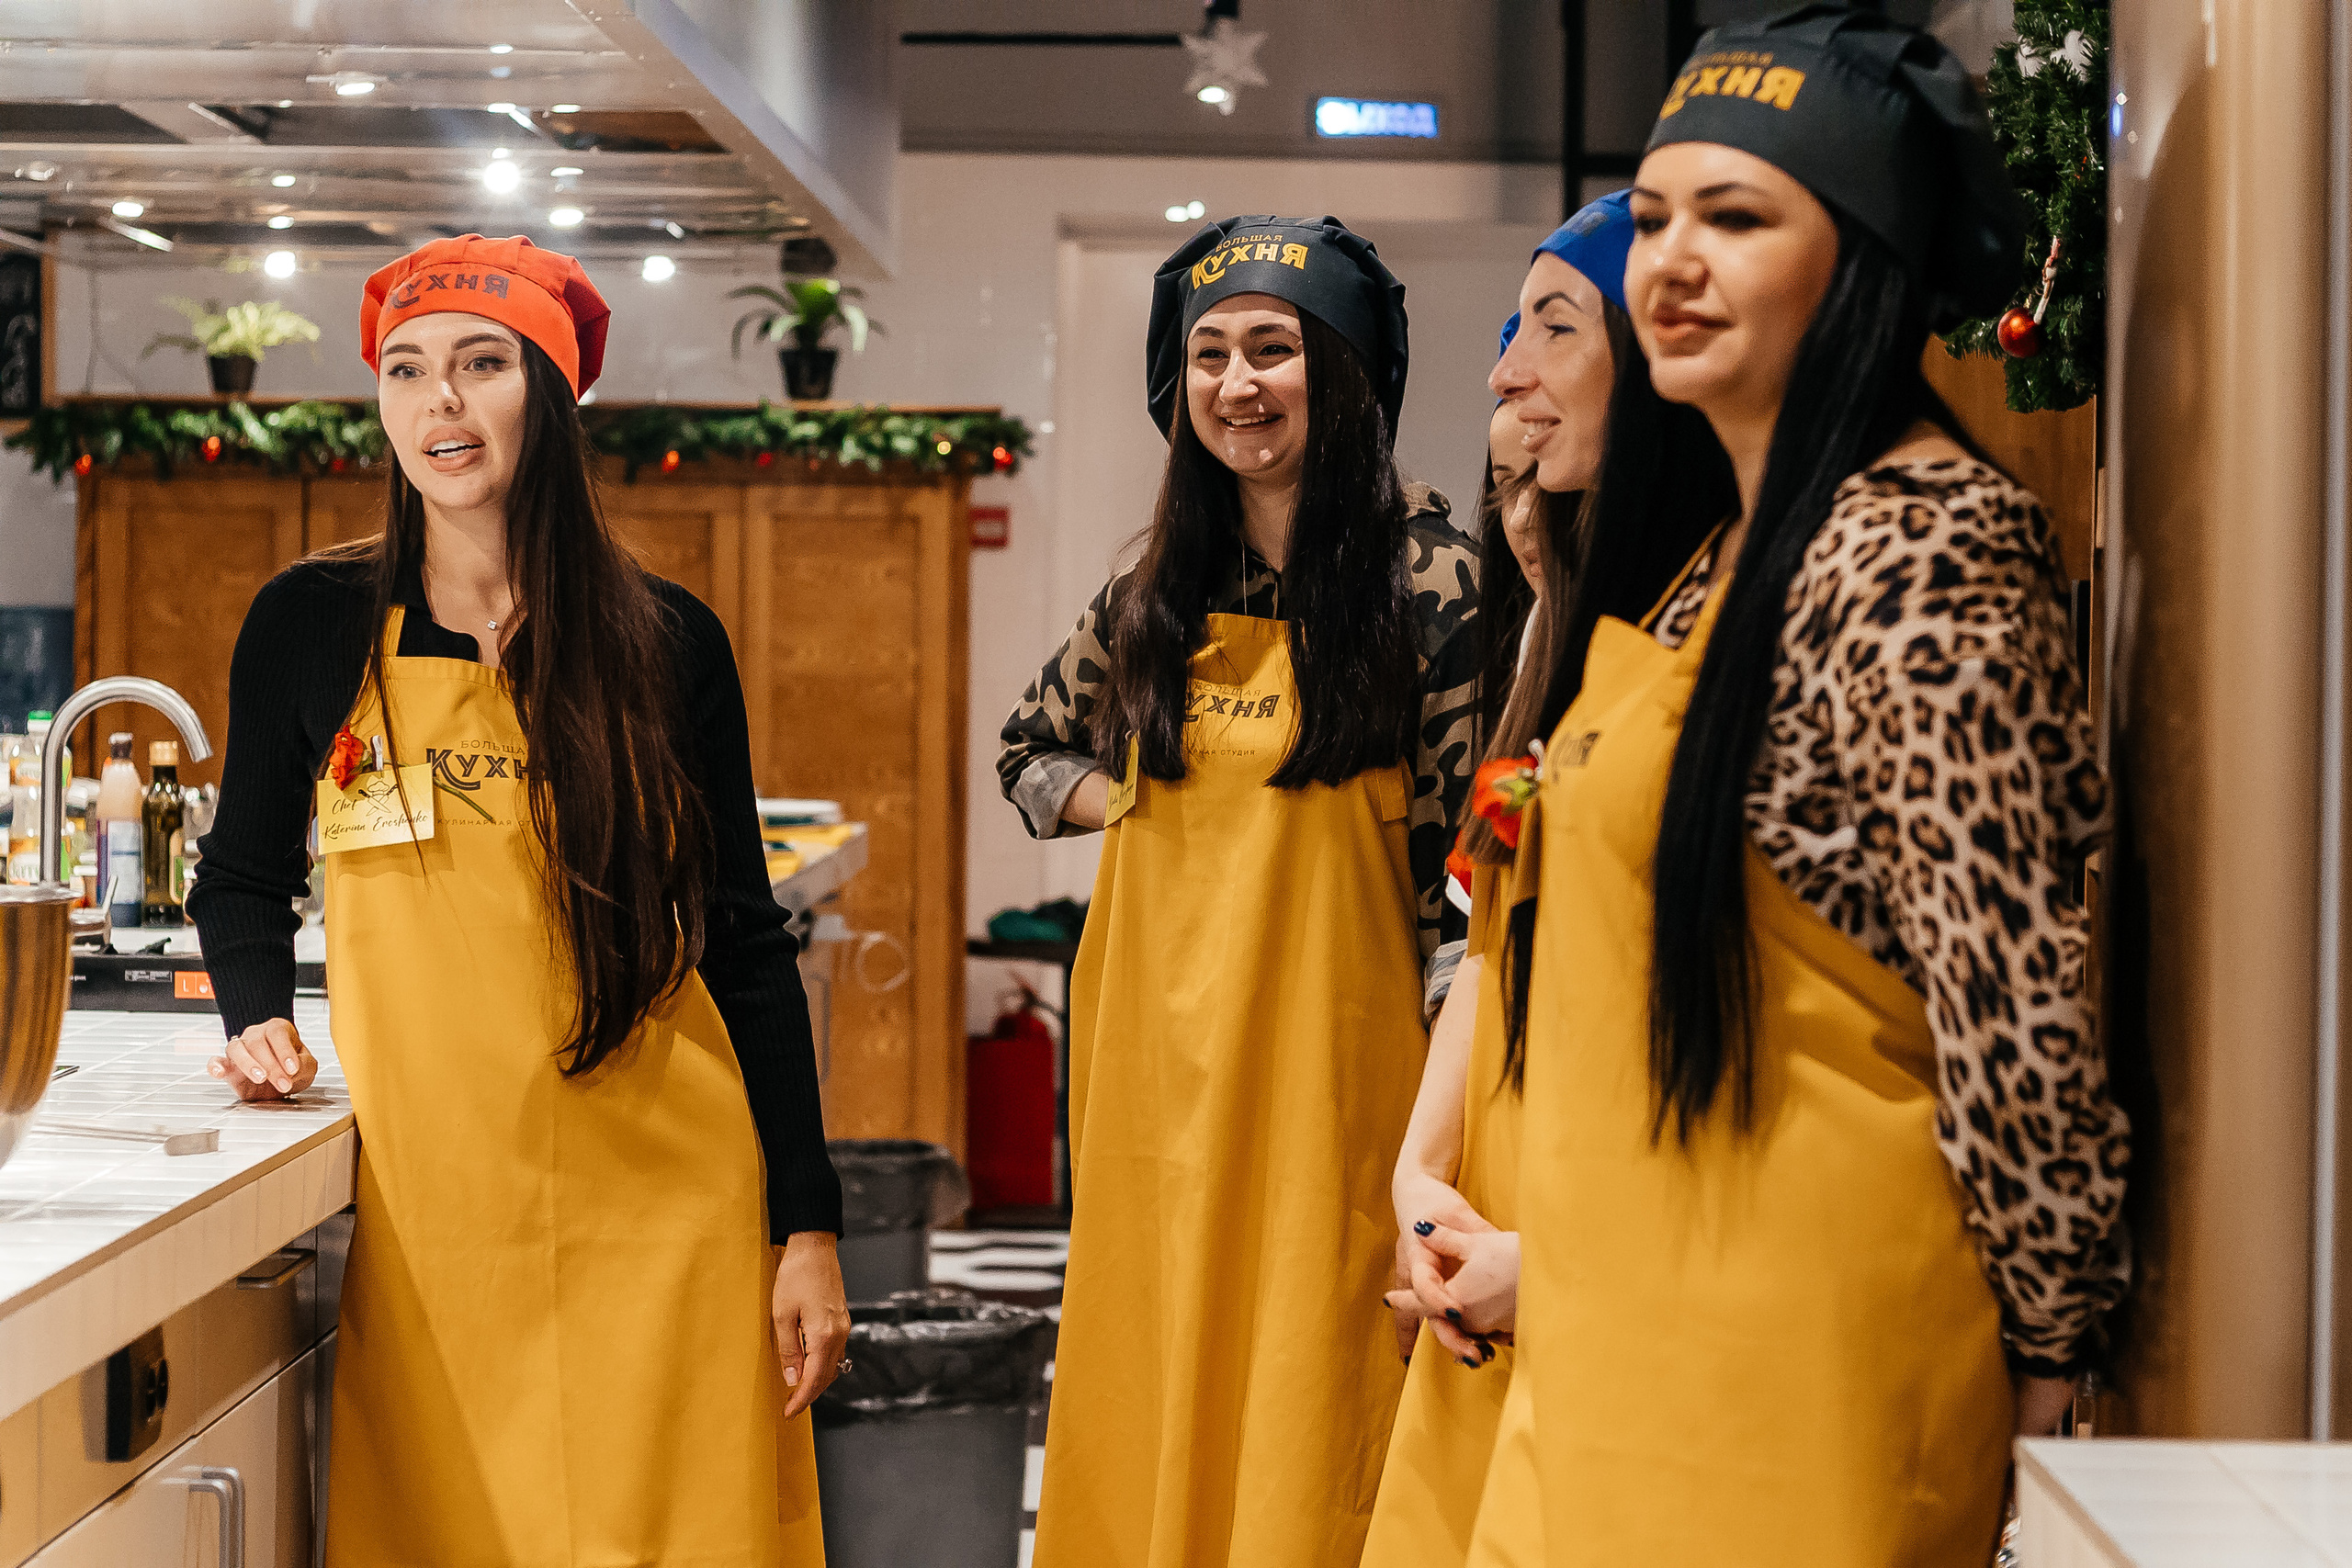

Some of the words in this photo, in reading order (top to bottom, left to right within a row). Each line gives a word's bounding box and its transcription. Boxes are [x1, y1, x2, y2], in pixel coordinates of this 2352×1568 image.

[1659, 65, 1807, 121] УХНЯ
[1215, 233, 1283, 253] БОЛЬШАЯ
[1191, 243, 1309, 290] КУХНЯ
[1184, 694, 1281, 723] УХНЯ
[460, 739, 526, 755] БОЛЬША
[425, 748, 529, 791] КУХН
[332, 798, 357, 815] Chef
[323, 822, 366, 840] Katerina
